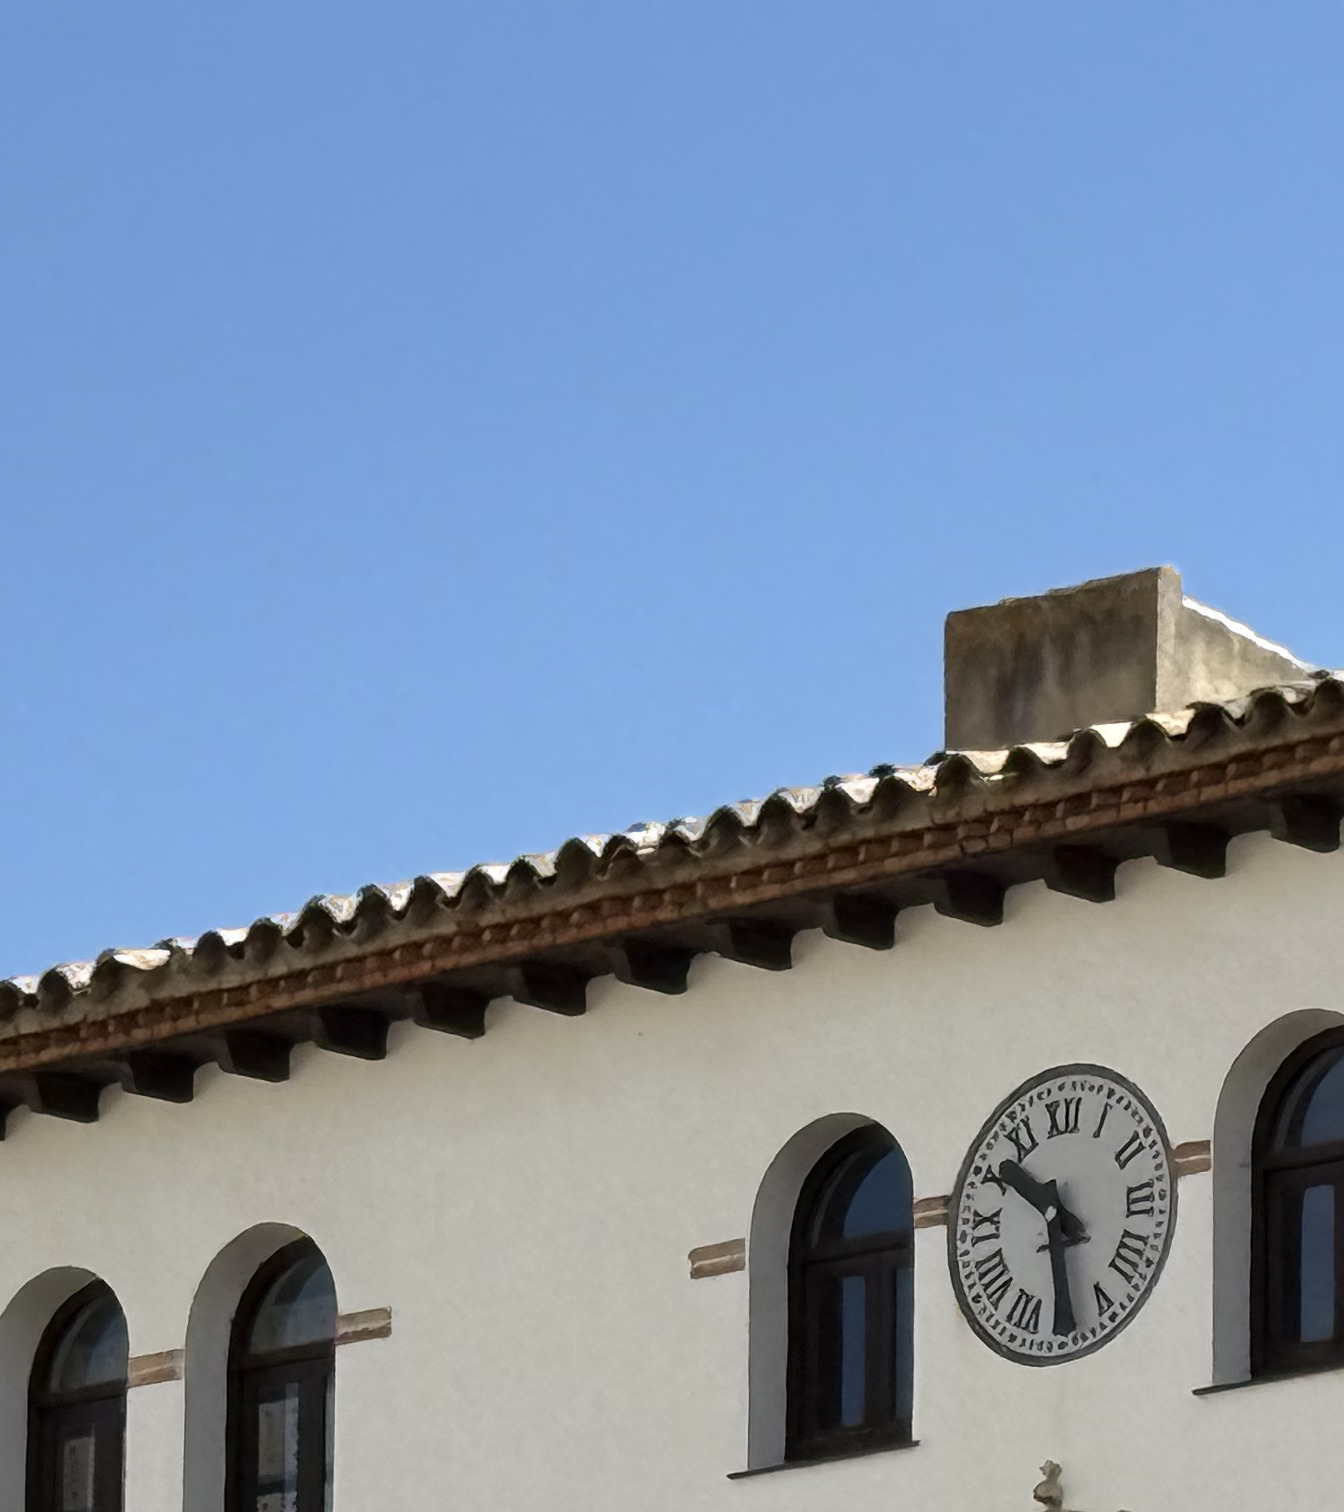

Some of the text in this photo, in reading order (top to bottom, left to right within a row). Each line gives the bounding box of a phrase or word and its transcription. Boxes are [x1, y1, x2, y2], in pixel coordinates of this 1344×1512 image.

[1045, 1097, 1082, 1139] XII
[1093, 1101, 1113, 1138] I
[1003, 1115, 1039, 1164] XI
[1115, 1130, 1146, 1170] II
[1126, 1179, 1155, 1218] III
[971, 1207, 1003, 1248] IX
[975, 1247, 1013, 1311] VIII
[1093, 1281, 1115, 1317] V
[1006, 1288, 1042, 1334] VII
